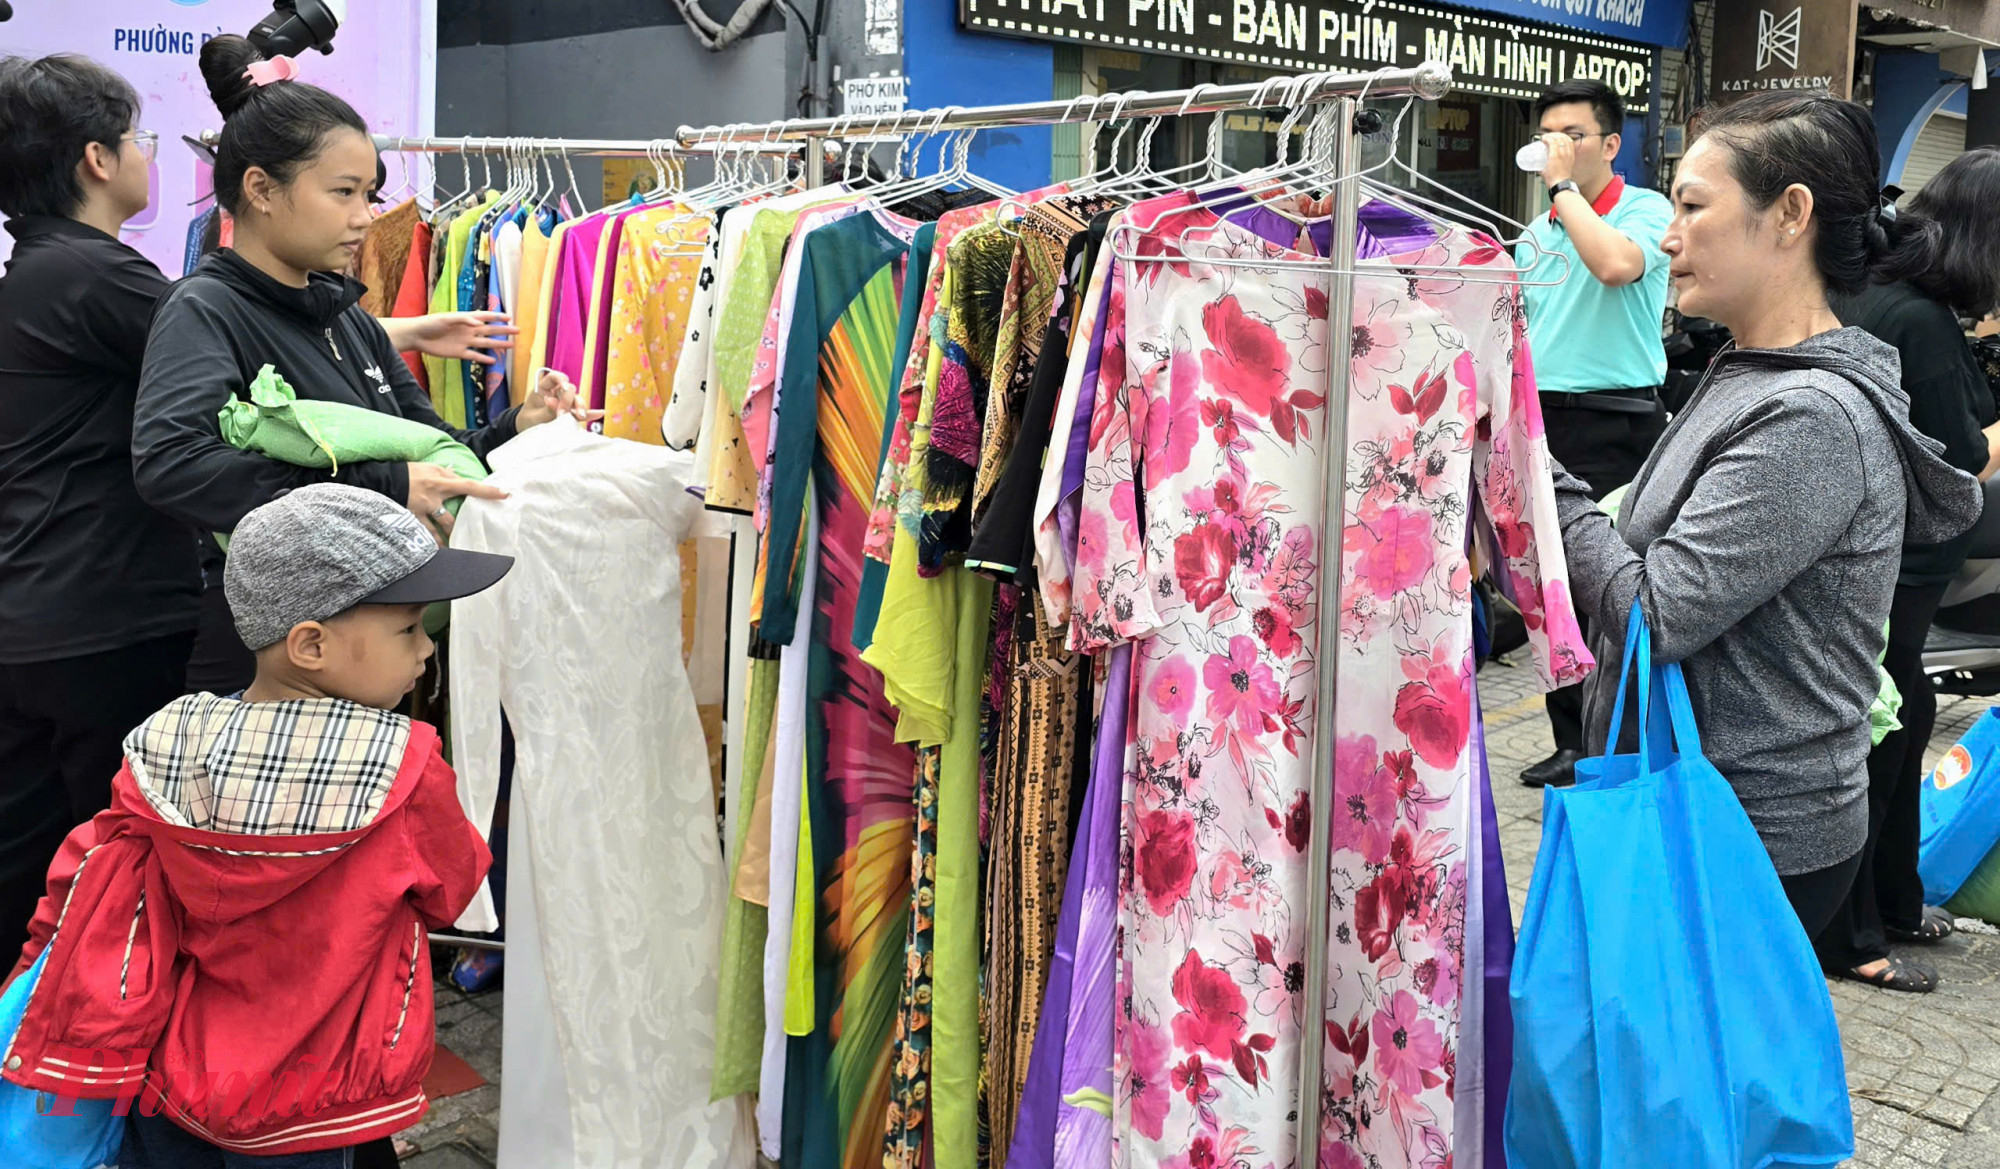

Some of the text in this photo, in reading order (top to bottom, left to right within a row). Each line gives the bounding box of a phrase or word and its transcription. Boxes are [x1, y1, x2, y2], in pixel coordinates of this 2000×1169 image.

[114, 23, 194, 55] PHƯỜNG
[1129, 0, 1194, 35] PIN
[1318, 0, 1397, 64] PHÍM
[1425, 17, 1486, 76] MÀN
[1494, 29, 1553, 85] HÌNH
[848, 80, 901, 99] PHỞ KIM
[1722, 80, 1750, 91] KAT
